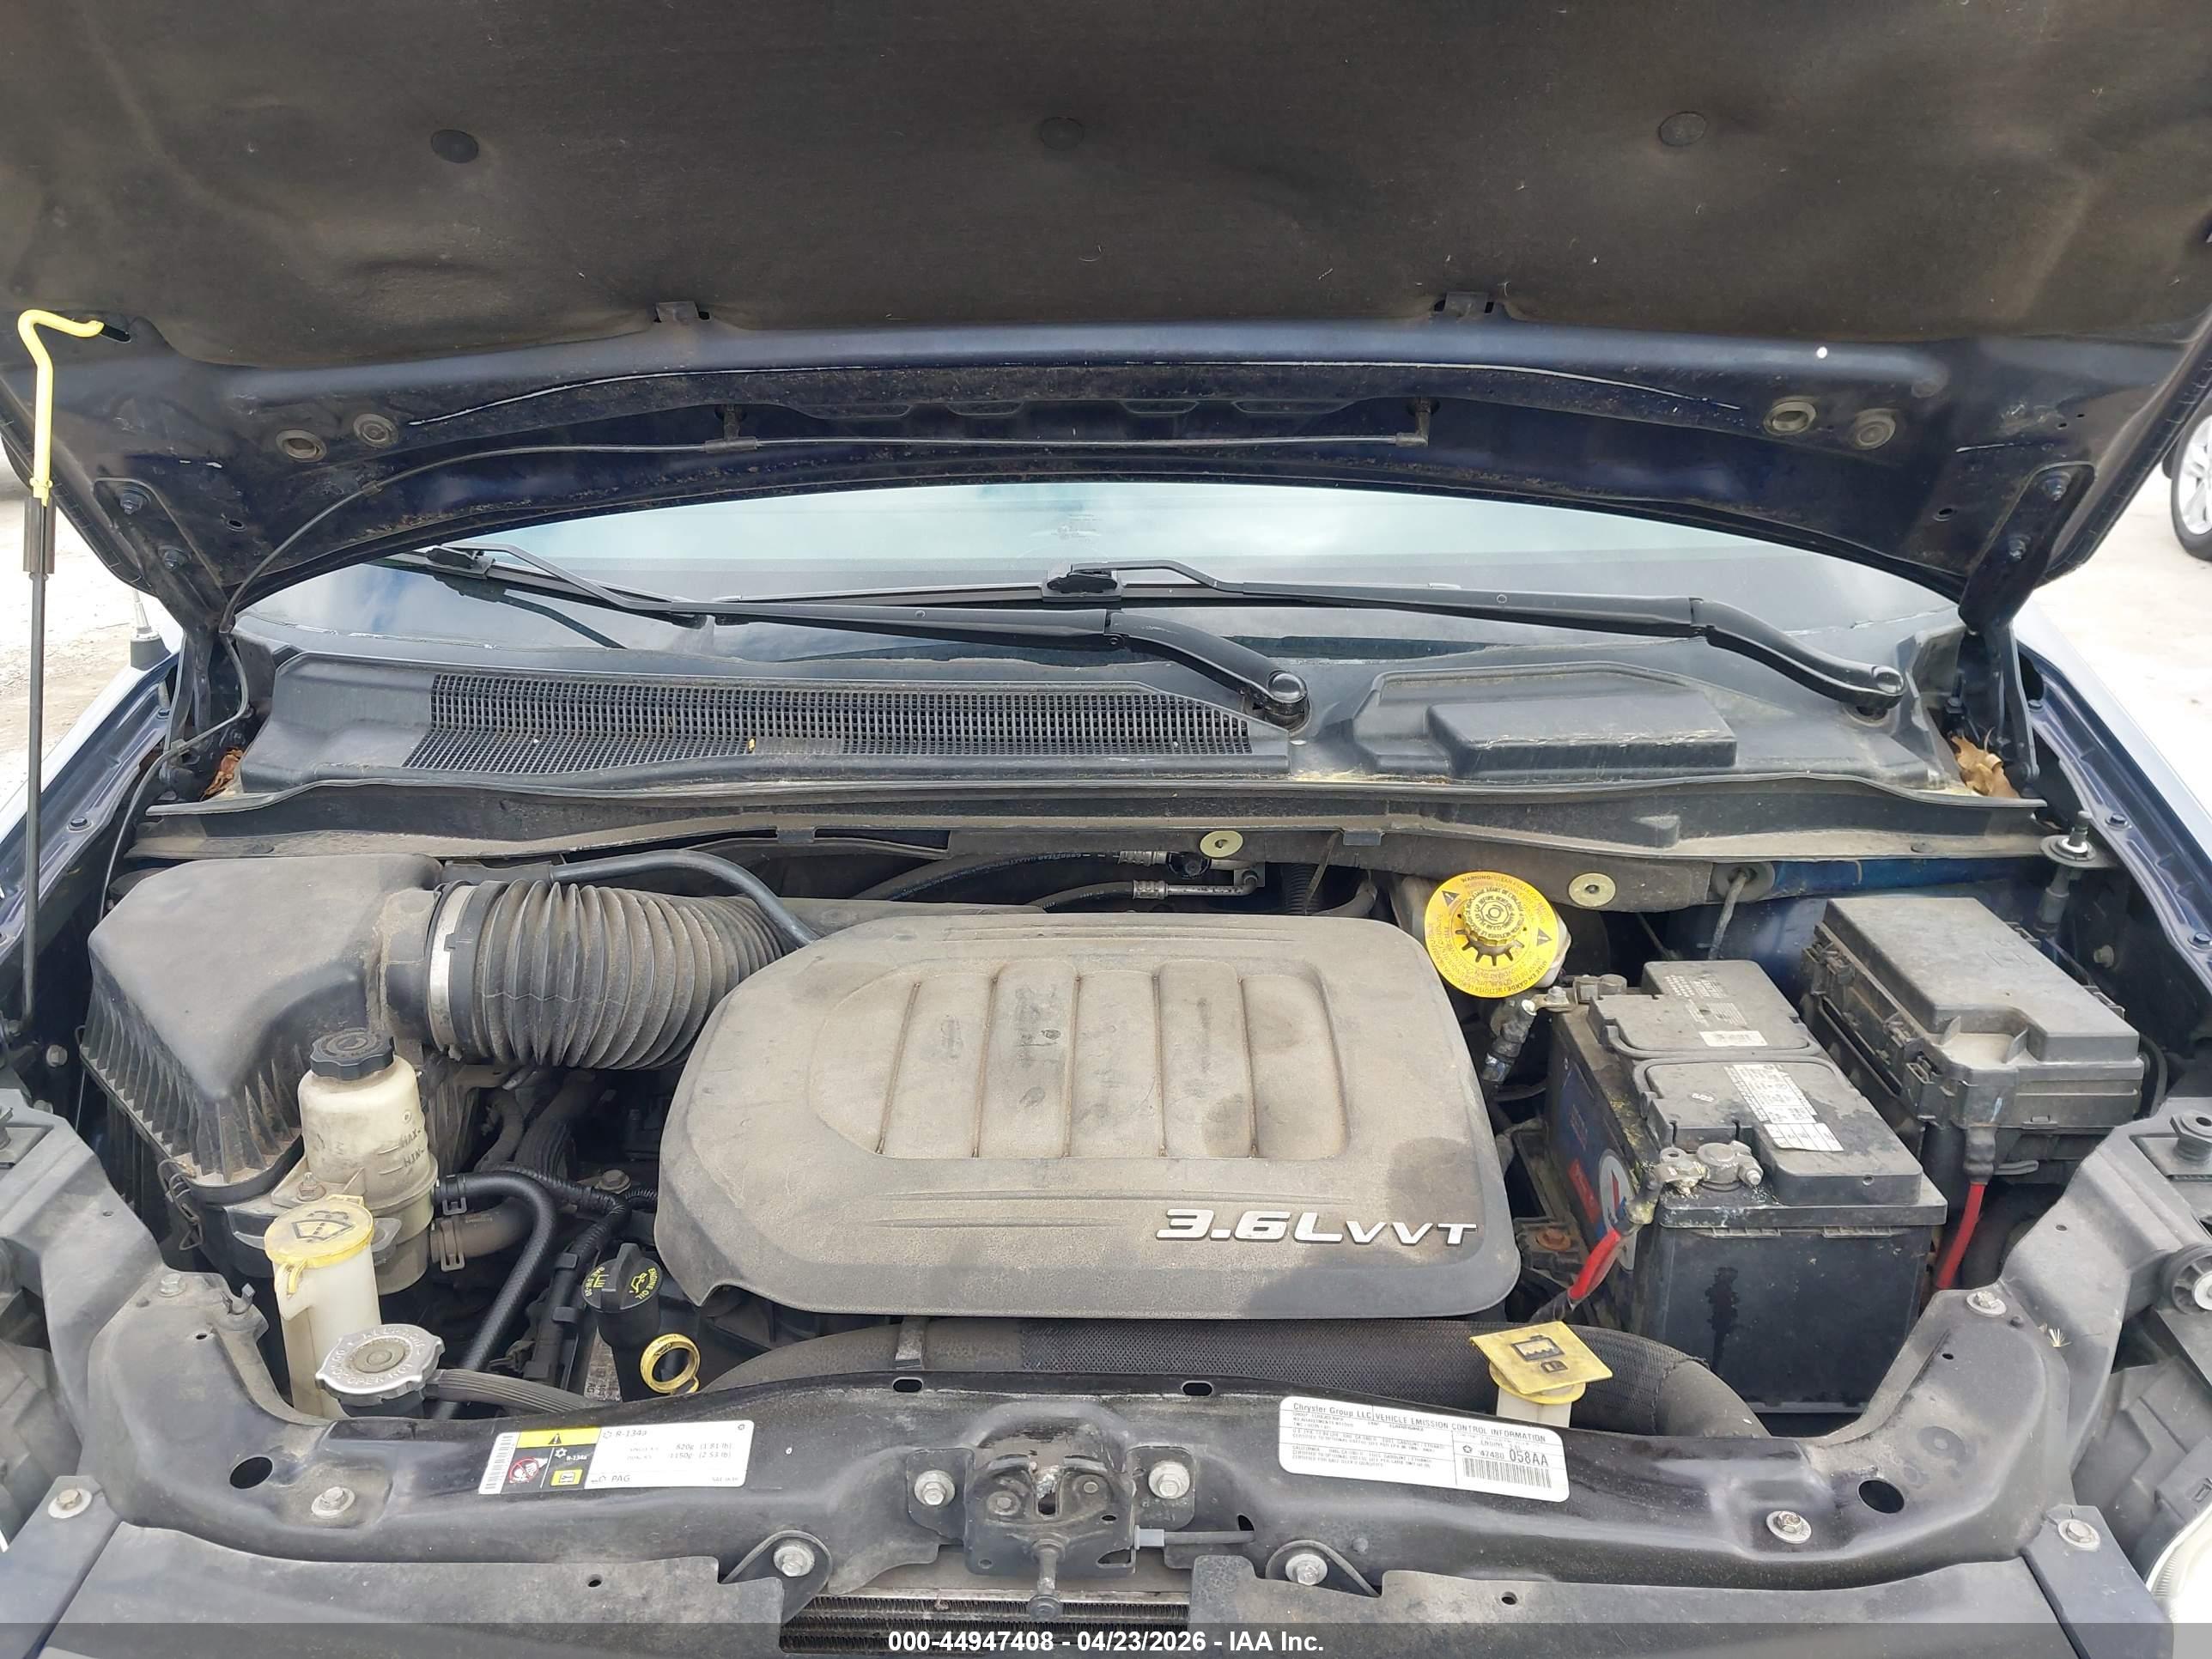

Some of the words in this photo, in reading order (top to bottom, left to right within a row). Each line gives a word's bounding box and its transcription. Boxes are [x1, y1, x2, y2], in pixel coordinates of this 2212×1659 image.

[1346, 1220, 1478, 1246] VVT
[646, 1267, 658, 1290] ENGINE
[635, 1290, 649, 1300] OIL
[1293, 1402, 1326, 1413] Chrysler
[1330, 1407, 1353, 1417] Group
[1357, 1410, 1371, 1419] LLC
[1376, 1413, 1407, 1424] VEHICLE
[1412, 1419, 1449, 1429] EMISSION
[1452, 1424, 1486, 1434] CONTROL
[1491, 1429, 1547, 1443] INFORMATION
[1509, 1449, 1549, 1466] 058AA
